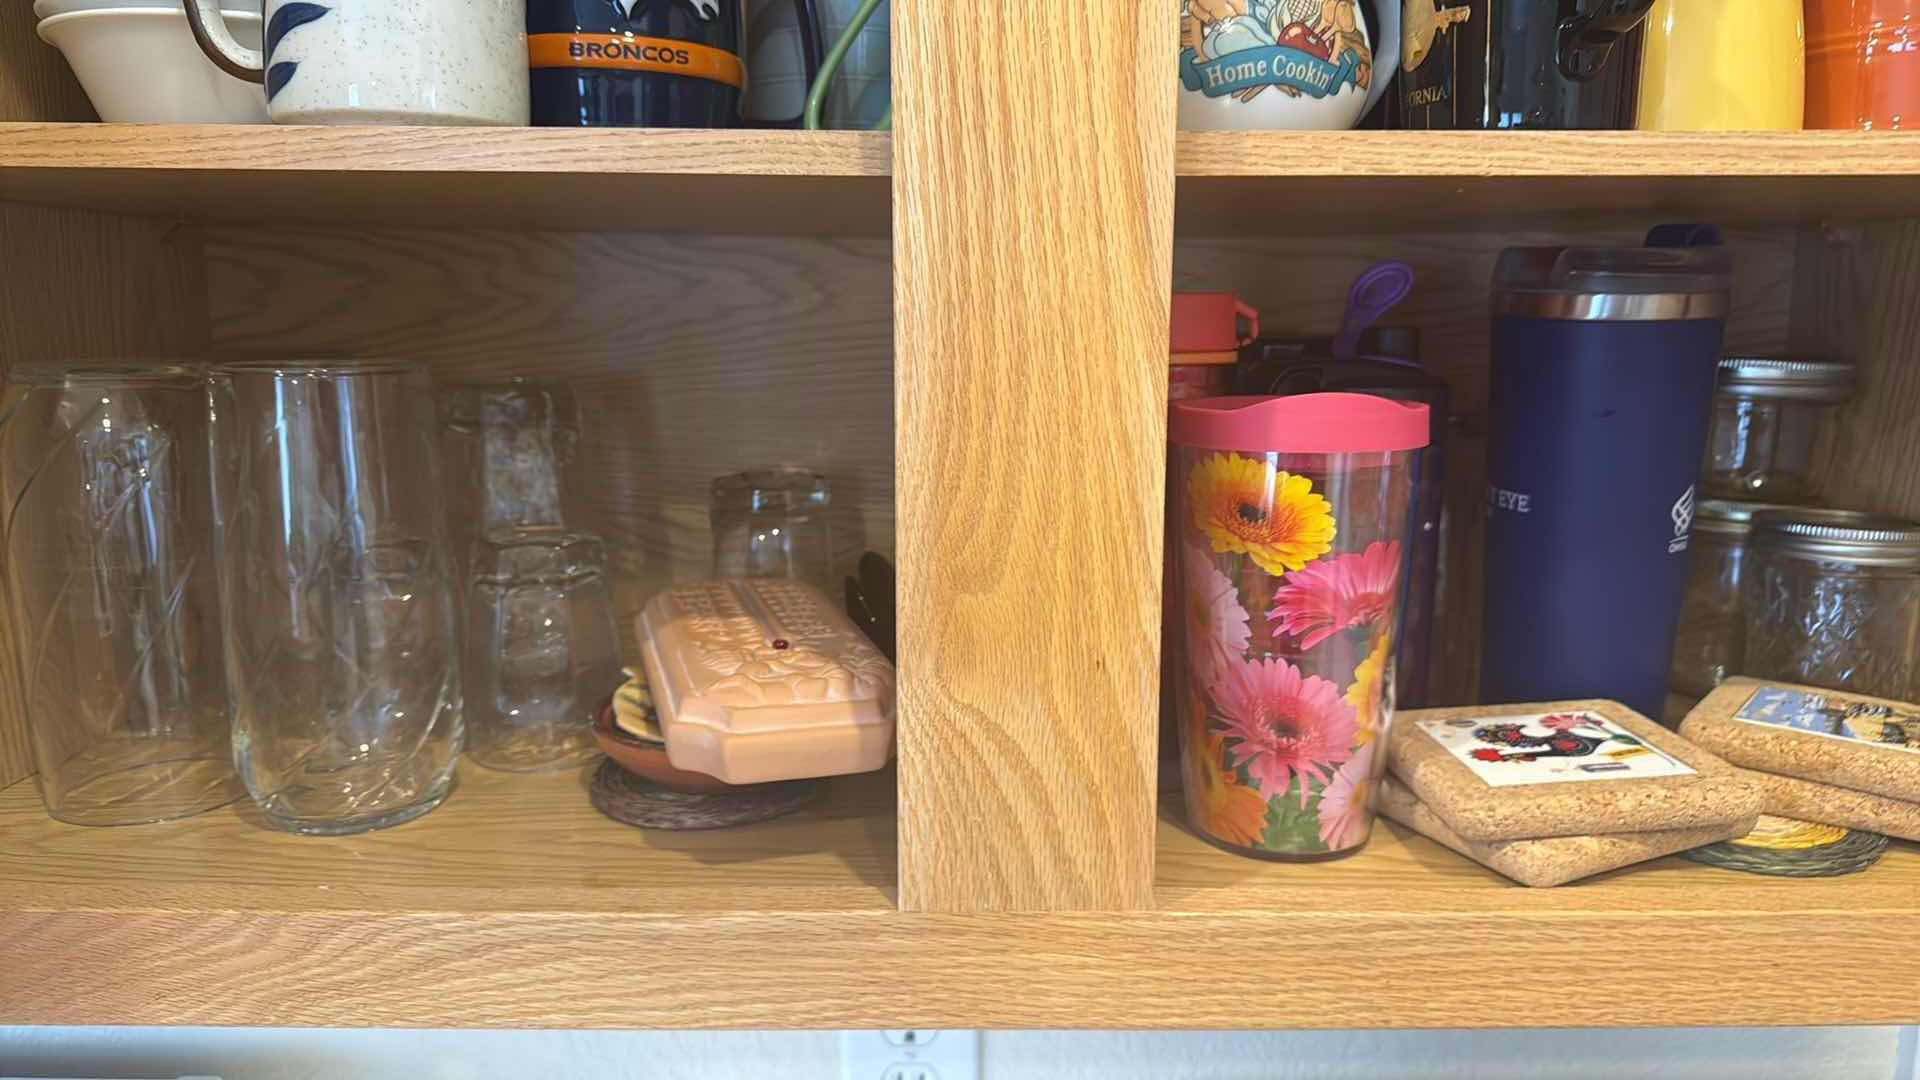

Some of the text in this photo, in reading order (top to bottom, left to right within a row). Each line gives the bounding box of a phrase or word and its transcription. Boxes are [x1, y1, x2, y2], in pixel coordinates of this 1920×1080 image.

[569, 42, 688, 64] BRONCOS
[1205, 55, 1334, 89] Home Cookin'
